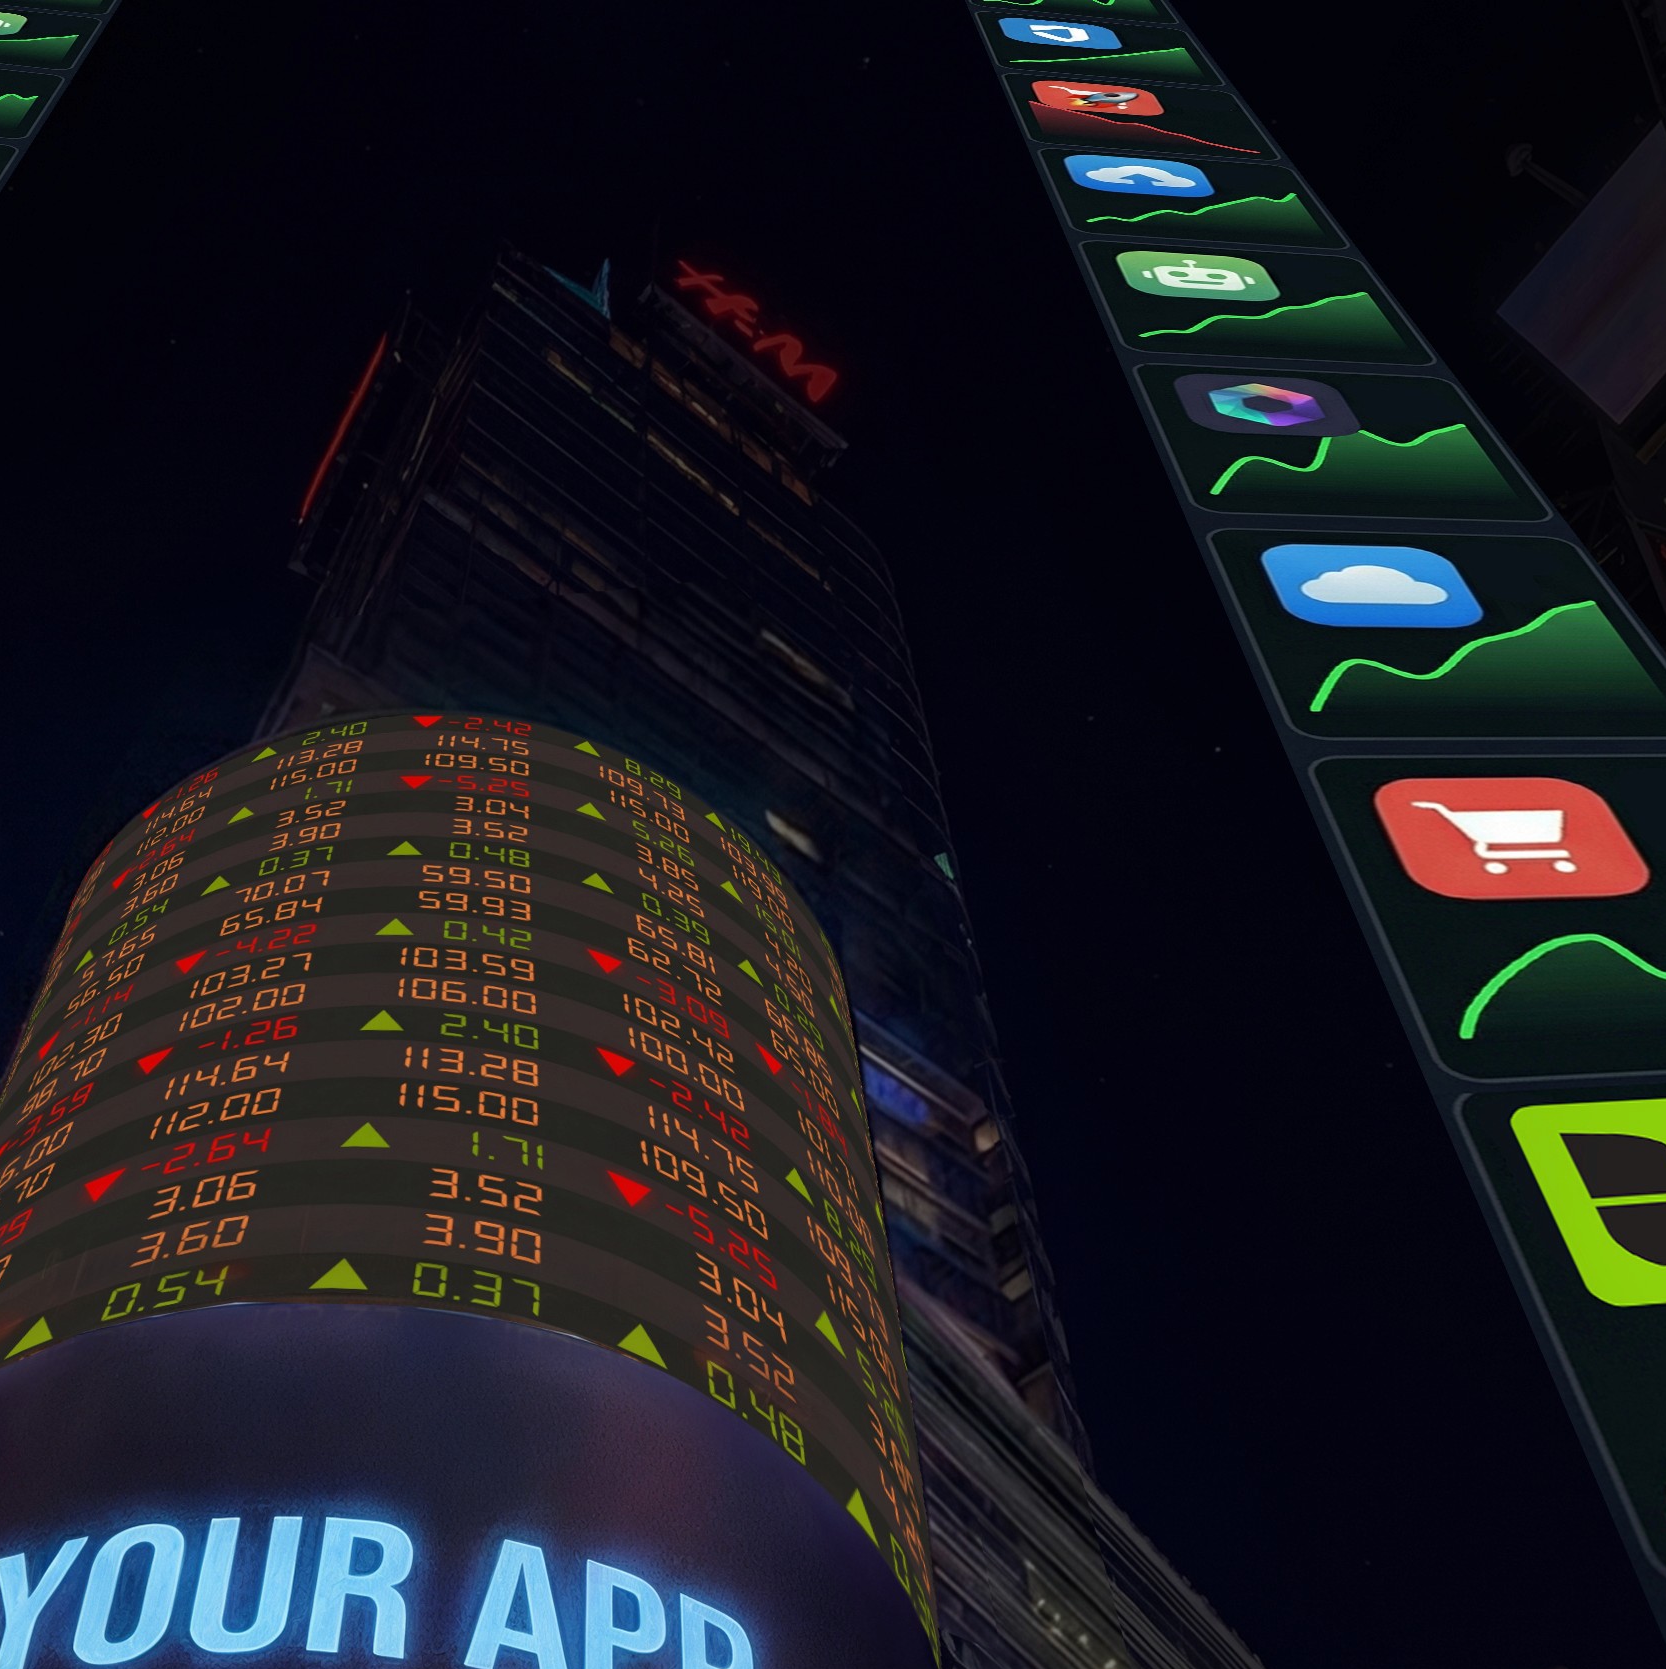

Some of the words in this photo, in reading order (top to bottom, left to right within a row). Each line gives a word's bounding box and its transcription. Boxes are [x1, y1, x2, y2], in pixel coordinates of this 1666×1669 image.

[302, 721, 367, 746] 2.40
[437, 735, 530, 756] 114.75
[448, 717, 532, 737] -2.42
[269, 758, 358, 791] 115.00
[276, 740, 364, 771] 113.28
[425, 753, 530, 777] 109.50
[625, 757, 682, 800] 8.29
[158, 767, 220, 804] -1.26
[304, 779, 353, 801] 1.71
[438, 775, 530, 798] -5.25
[454, 796, 530, 819] 3.04
[599, 765, 686, 821] 109.73
[136, 806, 206, 855] 112.00
[145, 786, 213, 834] 114.64
[275, 800, 346, 828] 3.52
[452, 818, 528, 843] 3.52
[610, 789, 690, 843] 115.00
[127, 828, 196, 874] -2.64
[268, 822, 341, 851] 3.90
[450, 842, 531, 868] 0.48
[632, 819, 695, 867] 5.26
[130, 851, 186, 895] 3.06
[258, 846, 334, 877] 0.37
[422, 864, 532, 895] 59.50
[636, 842, 699, 892] 3.85
[121, 873, 179, 919] 3.60
[235, 870, 331, 904] 70.07
[418, 890, 532, 922] 59.93
[638, 867, 705, 918] 4.25
[108, 898, 169, 946] 0.54
[216, 923, 318, 957] -4.22
[220, 897, 323, 936] 65.84
[443, 920, 533, 951] 0.42
[641, 892, 711, 946] 0.39
[79, 925, 157, 988] 57.65
[400, 947, 535, 982] 103.59
[635, 913, 716, 975] 65.81
[63, 953, 145, 1020] 56.50
[190, 952, 313, 999] 103.27
[627, 937, 722, 1006] 62.72
[70, 983, 134, 1030] -1.14
[178, 983, 306, 1031] 102.00
[398, 977, 537, 1015] 106.00
[637, 975, 730, 1039] -3.09
[29, 1013, 123, 1092] 102.30
[198, 1015, 299, 1051] -1.26
[440, 1013, 539, 1050] 2.40
[623, 993, 735, 1073] 102.42
[16, 1048, 107, 1125] 98.70
[164, 1051, 291, 1100] 114.64
[404, 1044, 539, 1087] 113.28
[628, 1027, 745, 1112] 100.00
[149, 1087, 282, 1140] 112.00
[398, 1082, 539, 1127] 115.00
[648, 1078, 751, 1151] -2.42
[141, 1127, 272, 1175] -2.64
[471, 1131, 544, 1170] 1.71
[648, 1105, 758, 1194] 114.75
[147, 1170, 260, 1220] 3.06
[429, 1167, 543, 1216] 3.52
[640, 1139, 768, 1241] 109.50
[129, 1214, 250, 1268] 3.60
[422, 1213, 542, 1265] 3.90
[665, 1203, 778, 1291] -5.25
[101, 1265, 229, 1322] 0.54
[412, 1261, 540, 1317] 0.37
[696, 1251, 788, 1344] 3.04
[702, 1304, 798, 1405] 3.52
[707, 1360, 806, 1467] 0.48
